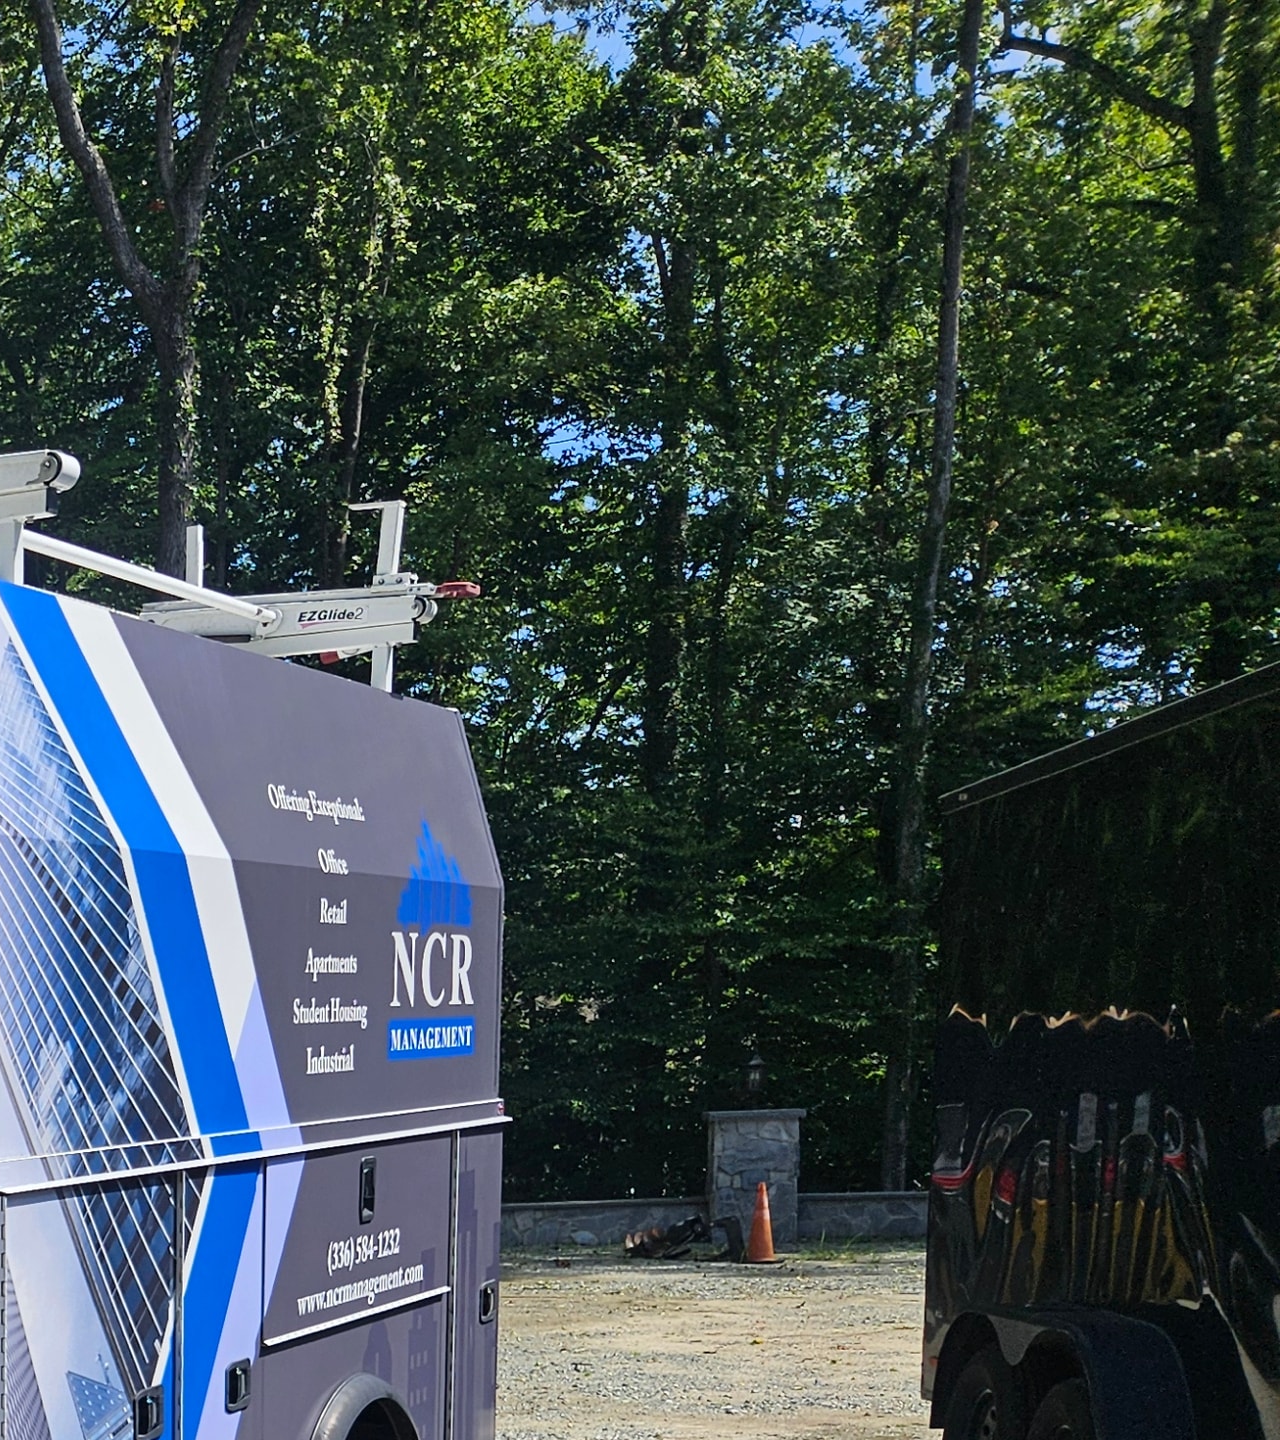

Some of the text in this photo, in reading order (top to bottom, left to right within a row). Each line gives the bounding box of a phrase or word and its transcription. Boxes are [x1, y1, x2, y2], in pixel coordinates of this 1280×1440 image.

[297, 607, 364, 622] EZGlide2
[268, 784, 313, 821] Offering
[318, 848, 349, 875] Office
[320, 898, 347, 924] Retail
[305, 948, 358, 982] Apartments
[390, 932, 474, 1008] NCR
[293, 997, 368, 1030] Student Housing
[390, 1026, 473, 1051] MANAGEMENT
[306, 1044, 355, 1075] Industrial
[327, 1228, 400, 1276] (336) 584-1232
[297, 1264, 424, 1316] www.ncrmanagement.com
